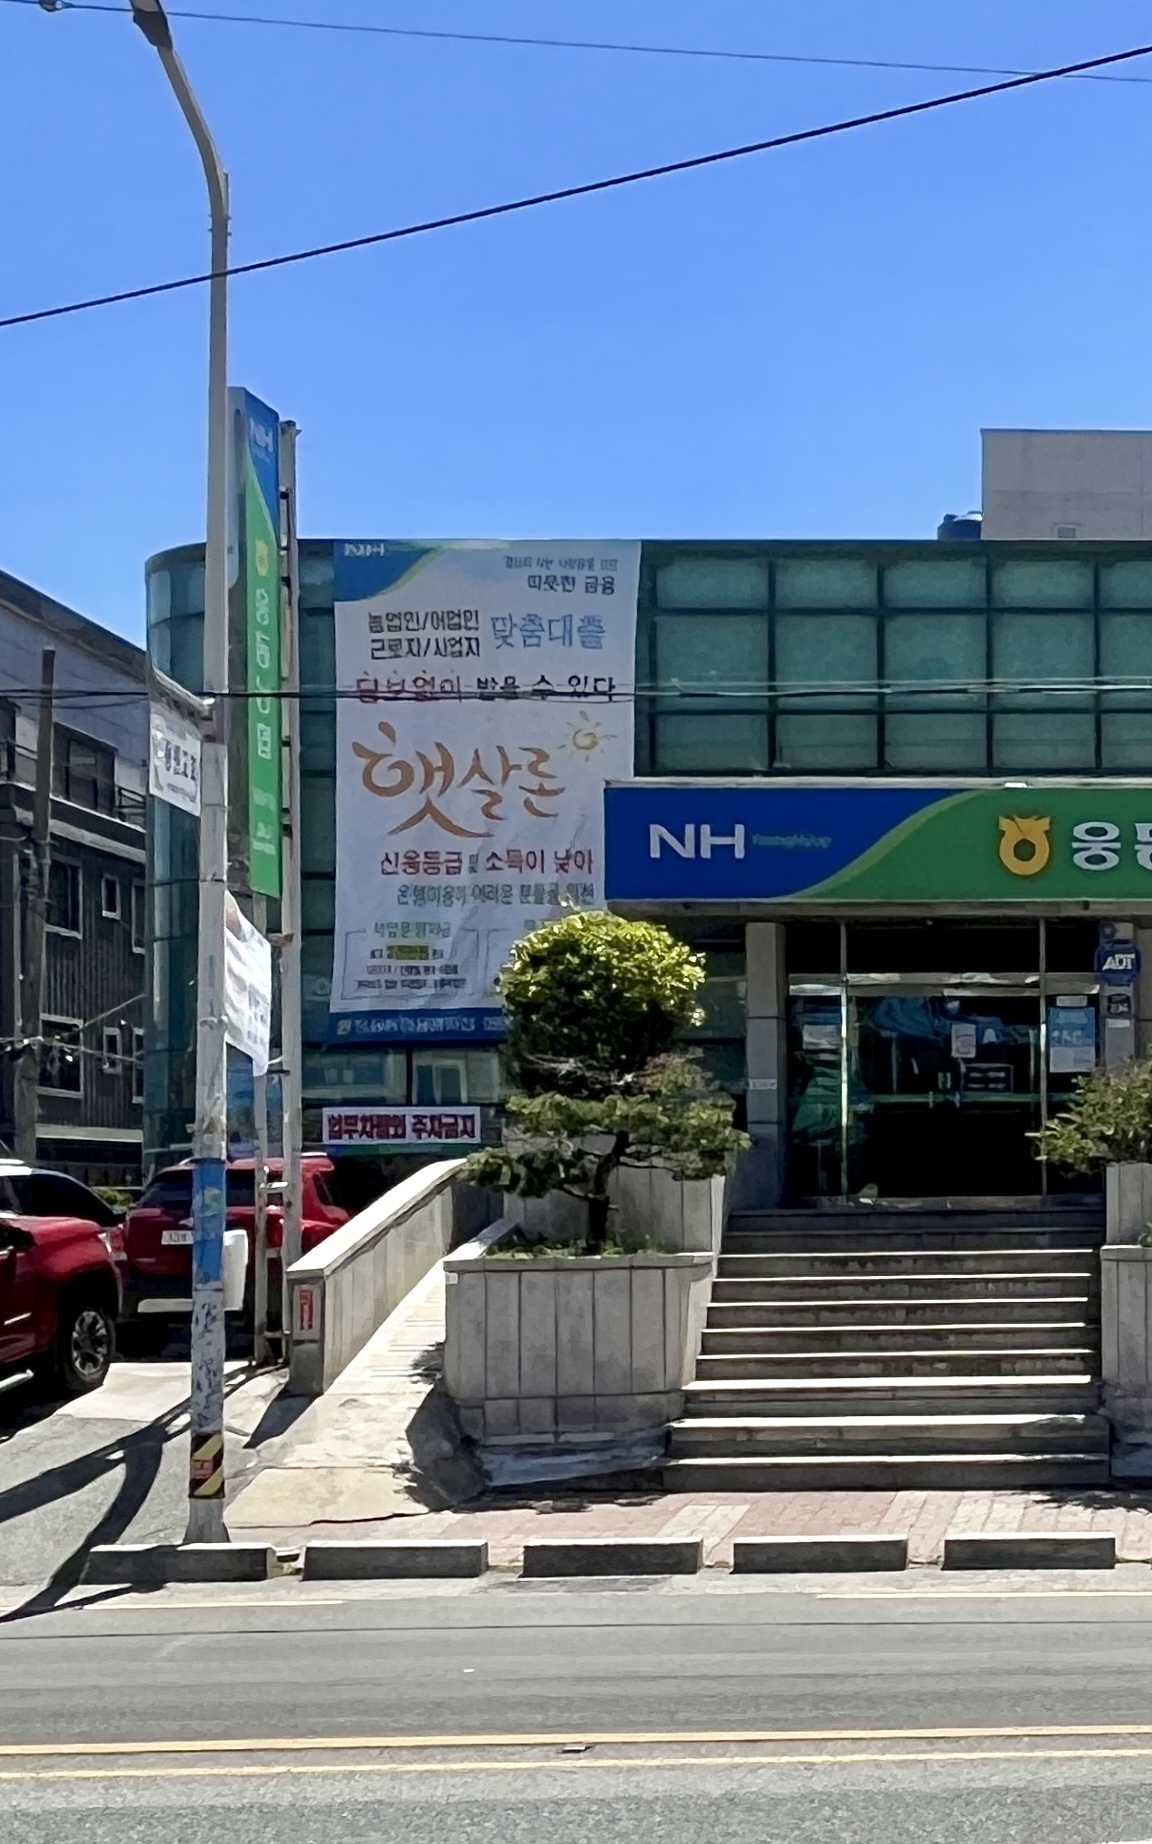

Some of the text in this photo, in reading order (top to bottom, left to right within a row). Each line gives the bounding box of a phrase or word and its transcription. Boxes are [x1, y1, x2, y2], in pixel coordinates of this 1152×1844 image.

[352, 721, 567, 838] 햇살론
[649, 823, 745, 859] NH
[380, 851, 463, 876] 신용등급
[1102, 953, 1136, 971] ADT
